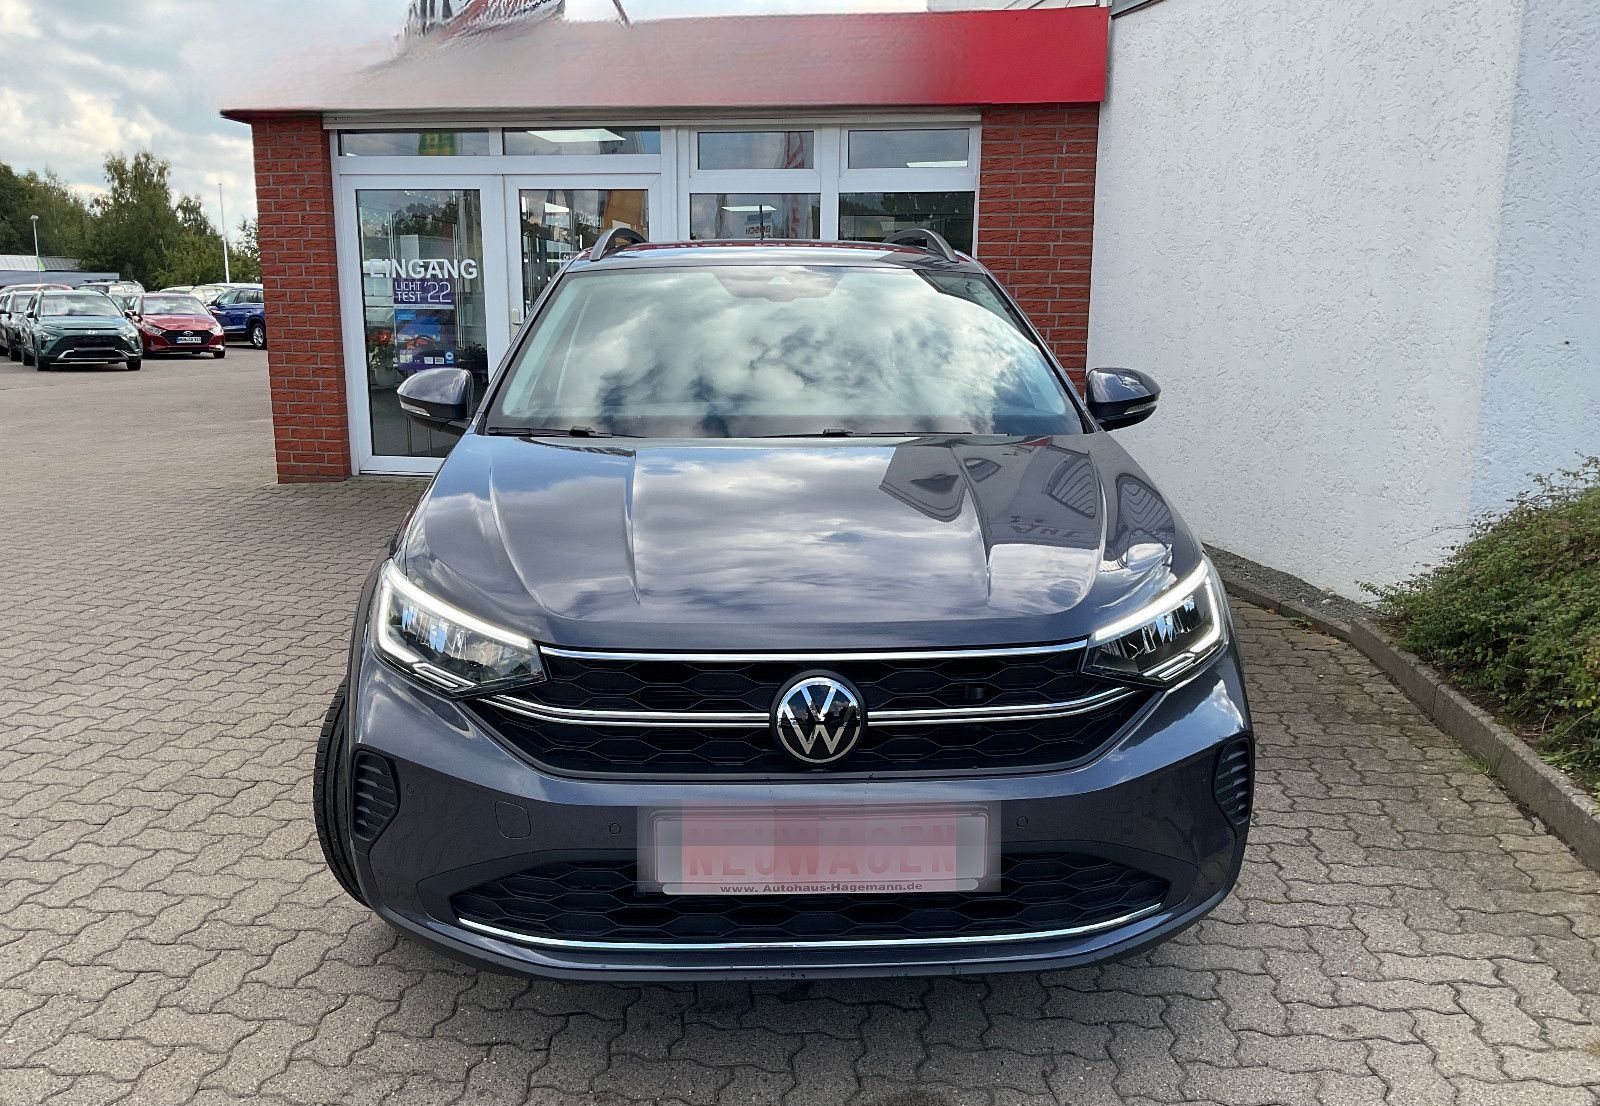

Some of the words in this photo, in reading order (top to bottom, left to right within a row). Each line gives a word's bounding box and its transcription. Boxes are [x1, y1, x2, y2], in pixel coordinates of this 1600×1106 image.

[369, 258, 478, 280] EINGANG
[395, 282, 422, 291] LICHT
[395, 292, 422, 302] TEST
[688, 825, 956, 877] NEUWAGEN
